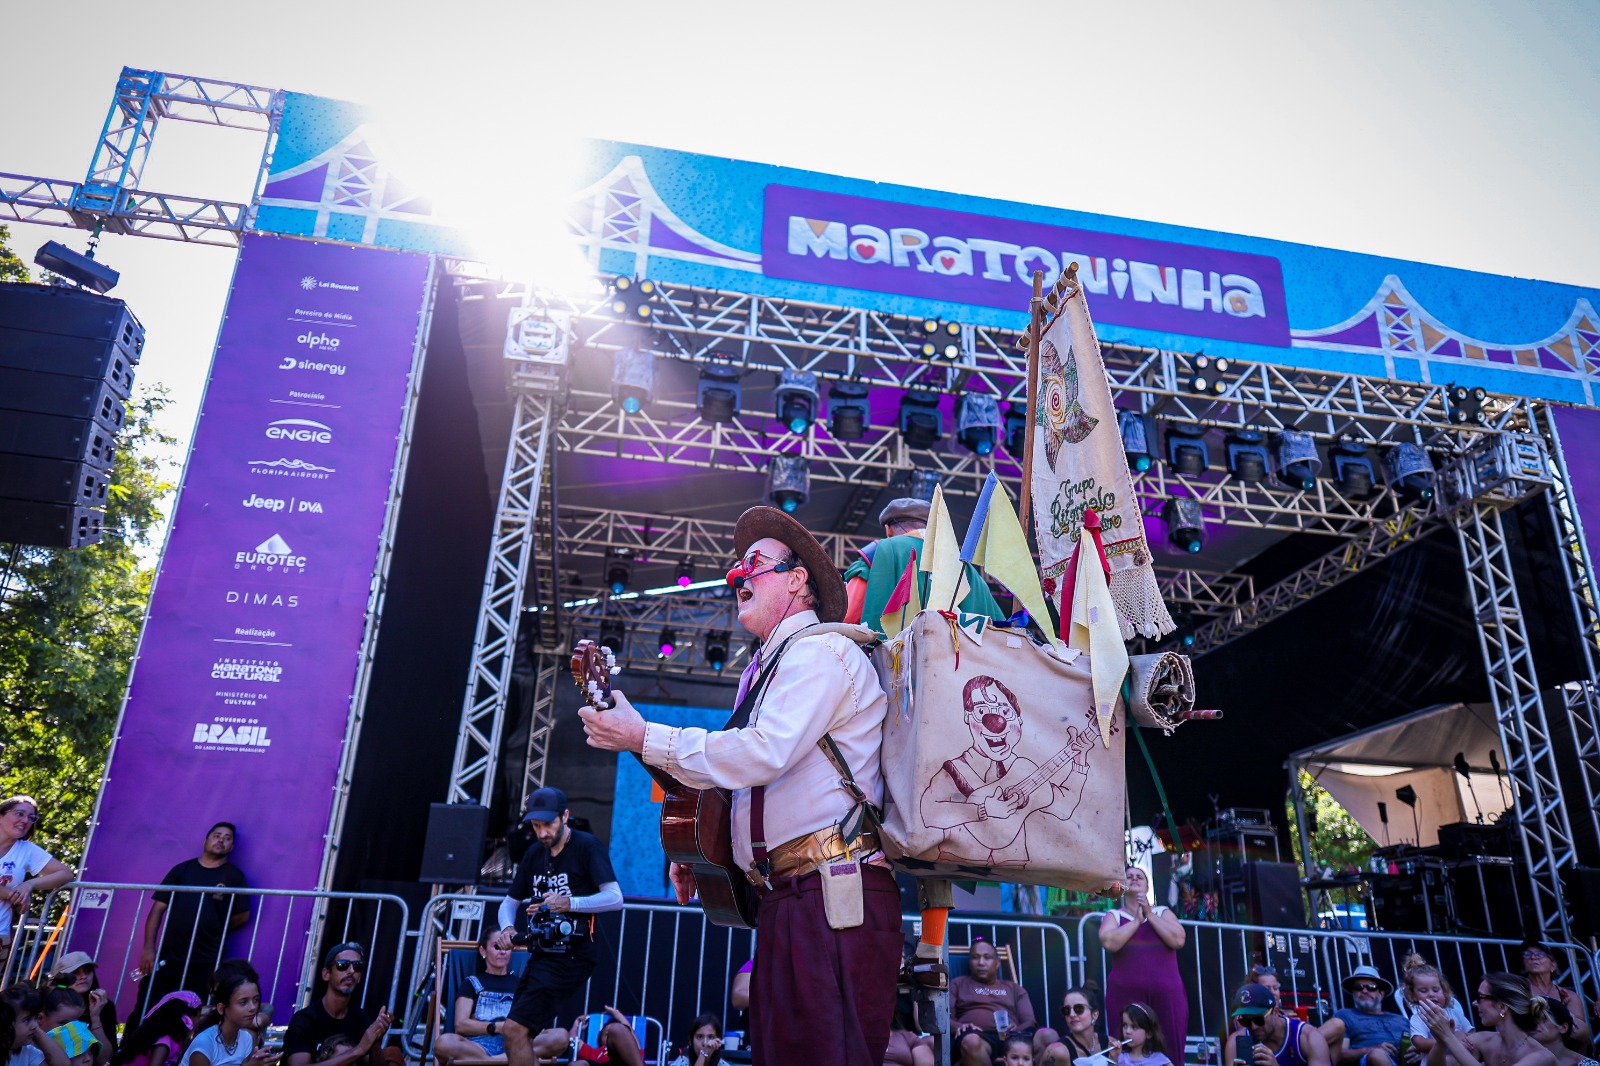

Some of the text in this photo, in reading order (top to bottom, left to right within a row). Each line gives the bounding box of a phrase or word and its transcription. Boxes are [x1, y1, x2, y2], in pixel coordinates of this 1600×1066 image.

[297, 331, 340, 349] alpha
[297, 359, 347, 376] sinergy
[250, 467, 330, 480] FLORIPA AIRPORT
[1059, 478, 1096, 500] Grupo
[242, 493, 324, 514] Jeep DVA
[235, 551, 307, 567] EUROTEC
[234, 562, 305, 575] GROUP
[226, 591, 299, 608] DIMAS
[234, 627, 276, 639] Realização
[218, 657, 279, 667] INSTITUTO
[214, 716, 247, 724] GOVERNO
[193, 723, 271, 747] BRASIL
